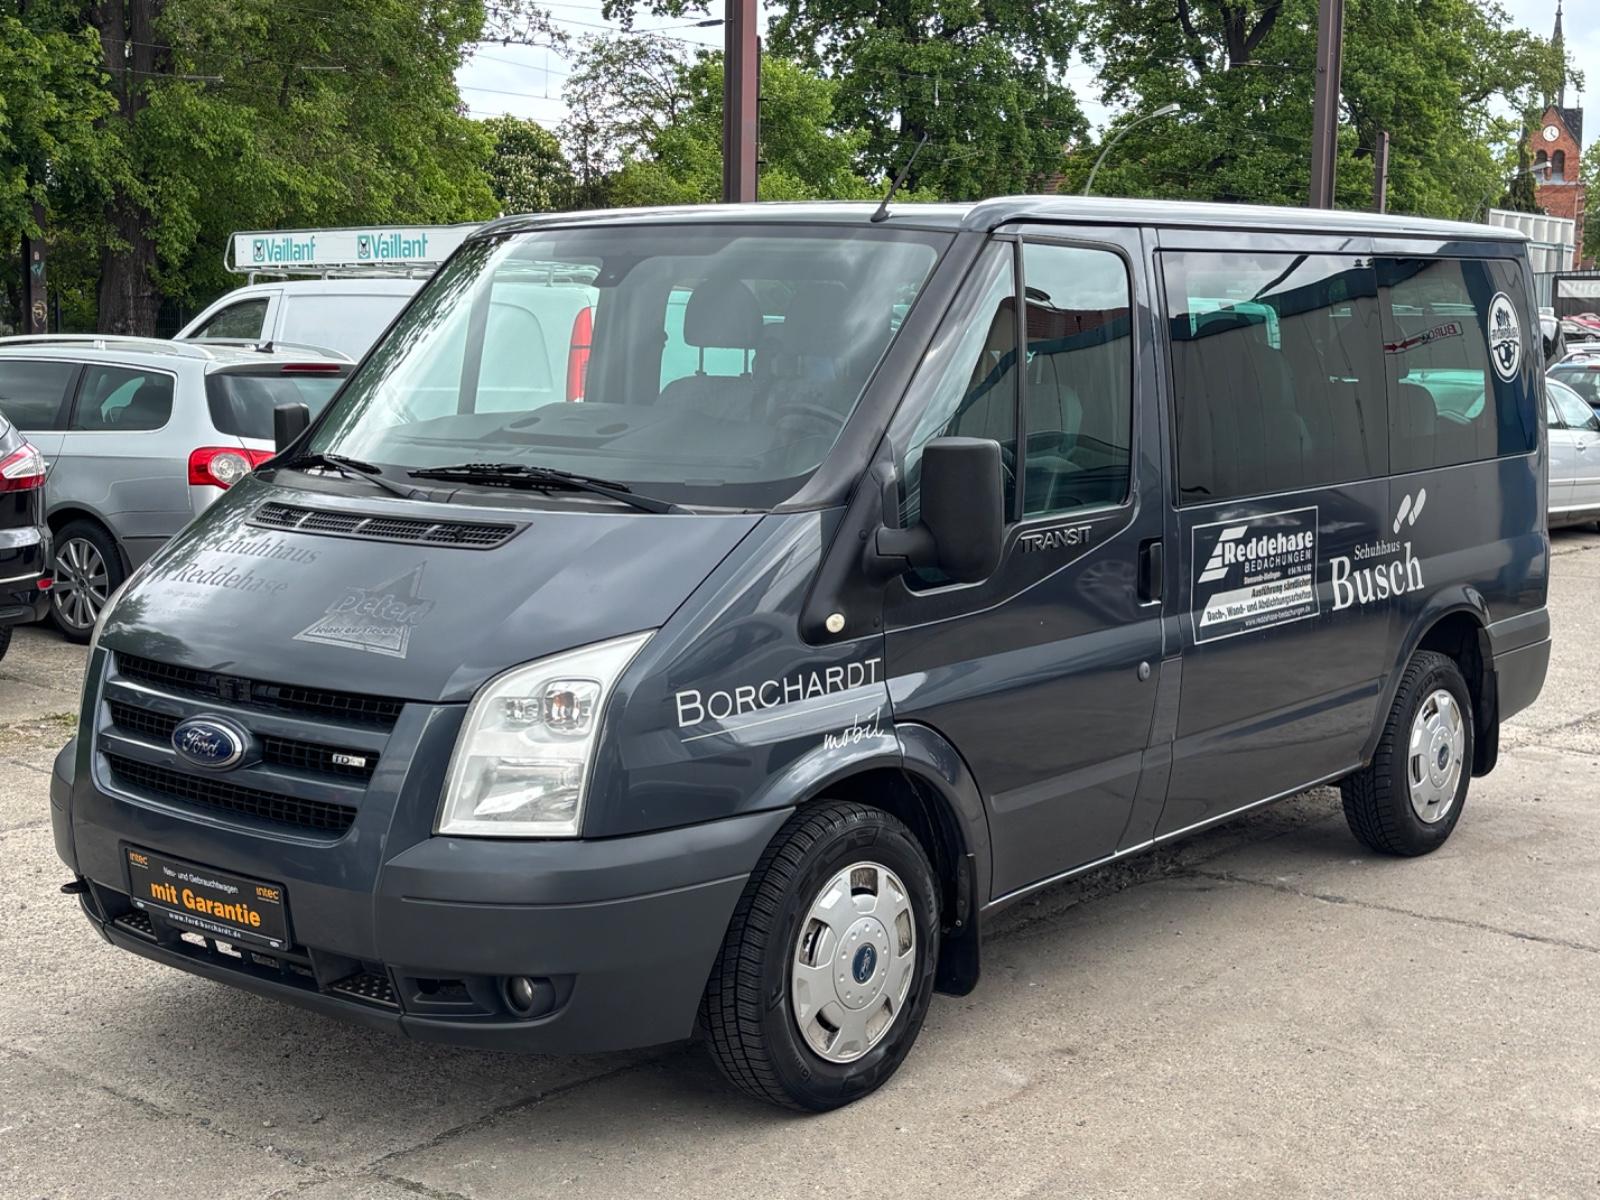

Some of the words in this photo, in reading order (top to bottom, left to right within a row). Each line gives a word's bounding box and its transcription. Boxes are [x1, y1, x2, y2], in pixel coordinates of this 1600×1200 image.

[265, 236, 316, 262] Vaillant
[371, 232, 428, 259] Vaillant
[1020, 525, 1092, 553] TRANSIT
[1224, 530, 1313, 565] Reddehase
[1354, 539, 1401, 561] Schuhhaus
[1244, 549, 1312, 573] BEDACHUNGEN
[1329, 541, 1425, 611] Busch
[1246, 600, 1258, 612] und
[675, 657, 882, 728] BORCHARDT
[182, 725, 221, 757] Ford
[823, 706, 885, 750] mobil
[177, 872, 189, 882] und
[150, 881, 179, 905] mit
[181, 888, 261, 927] Garantie
